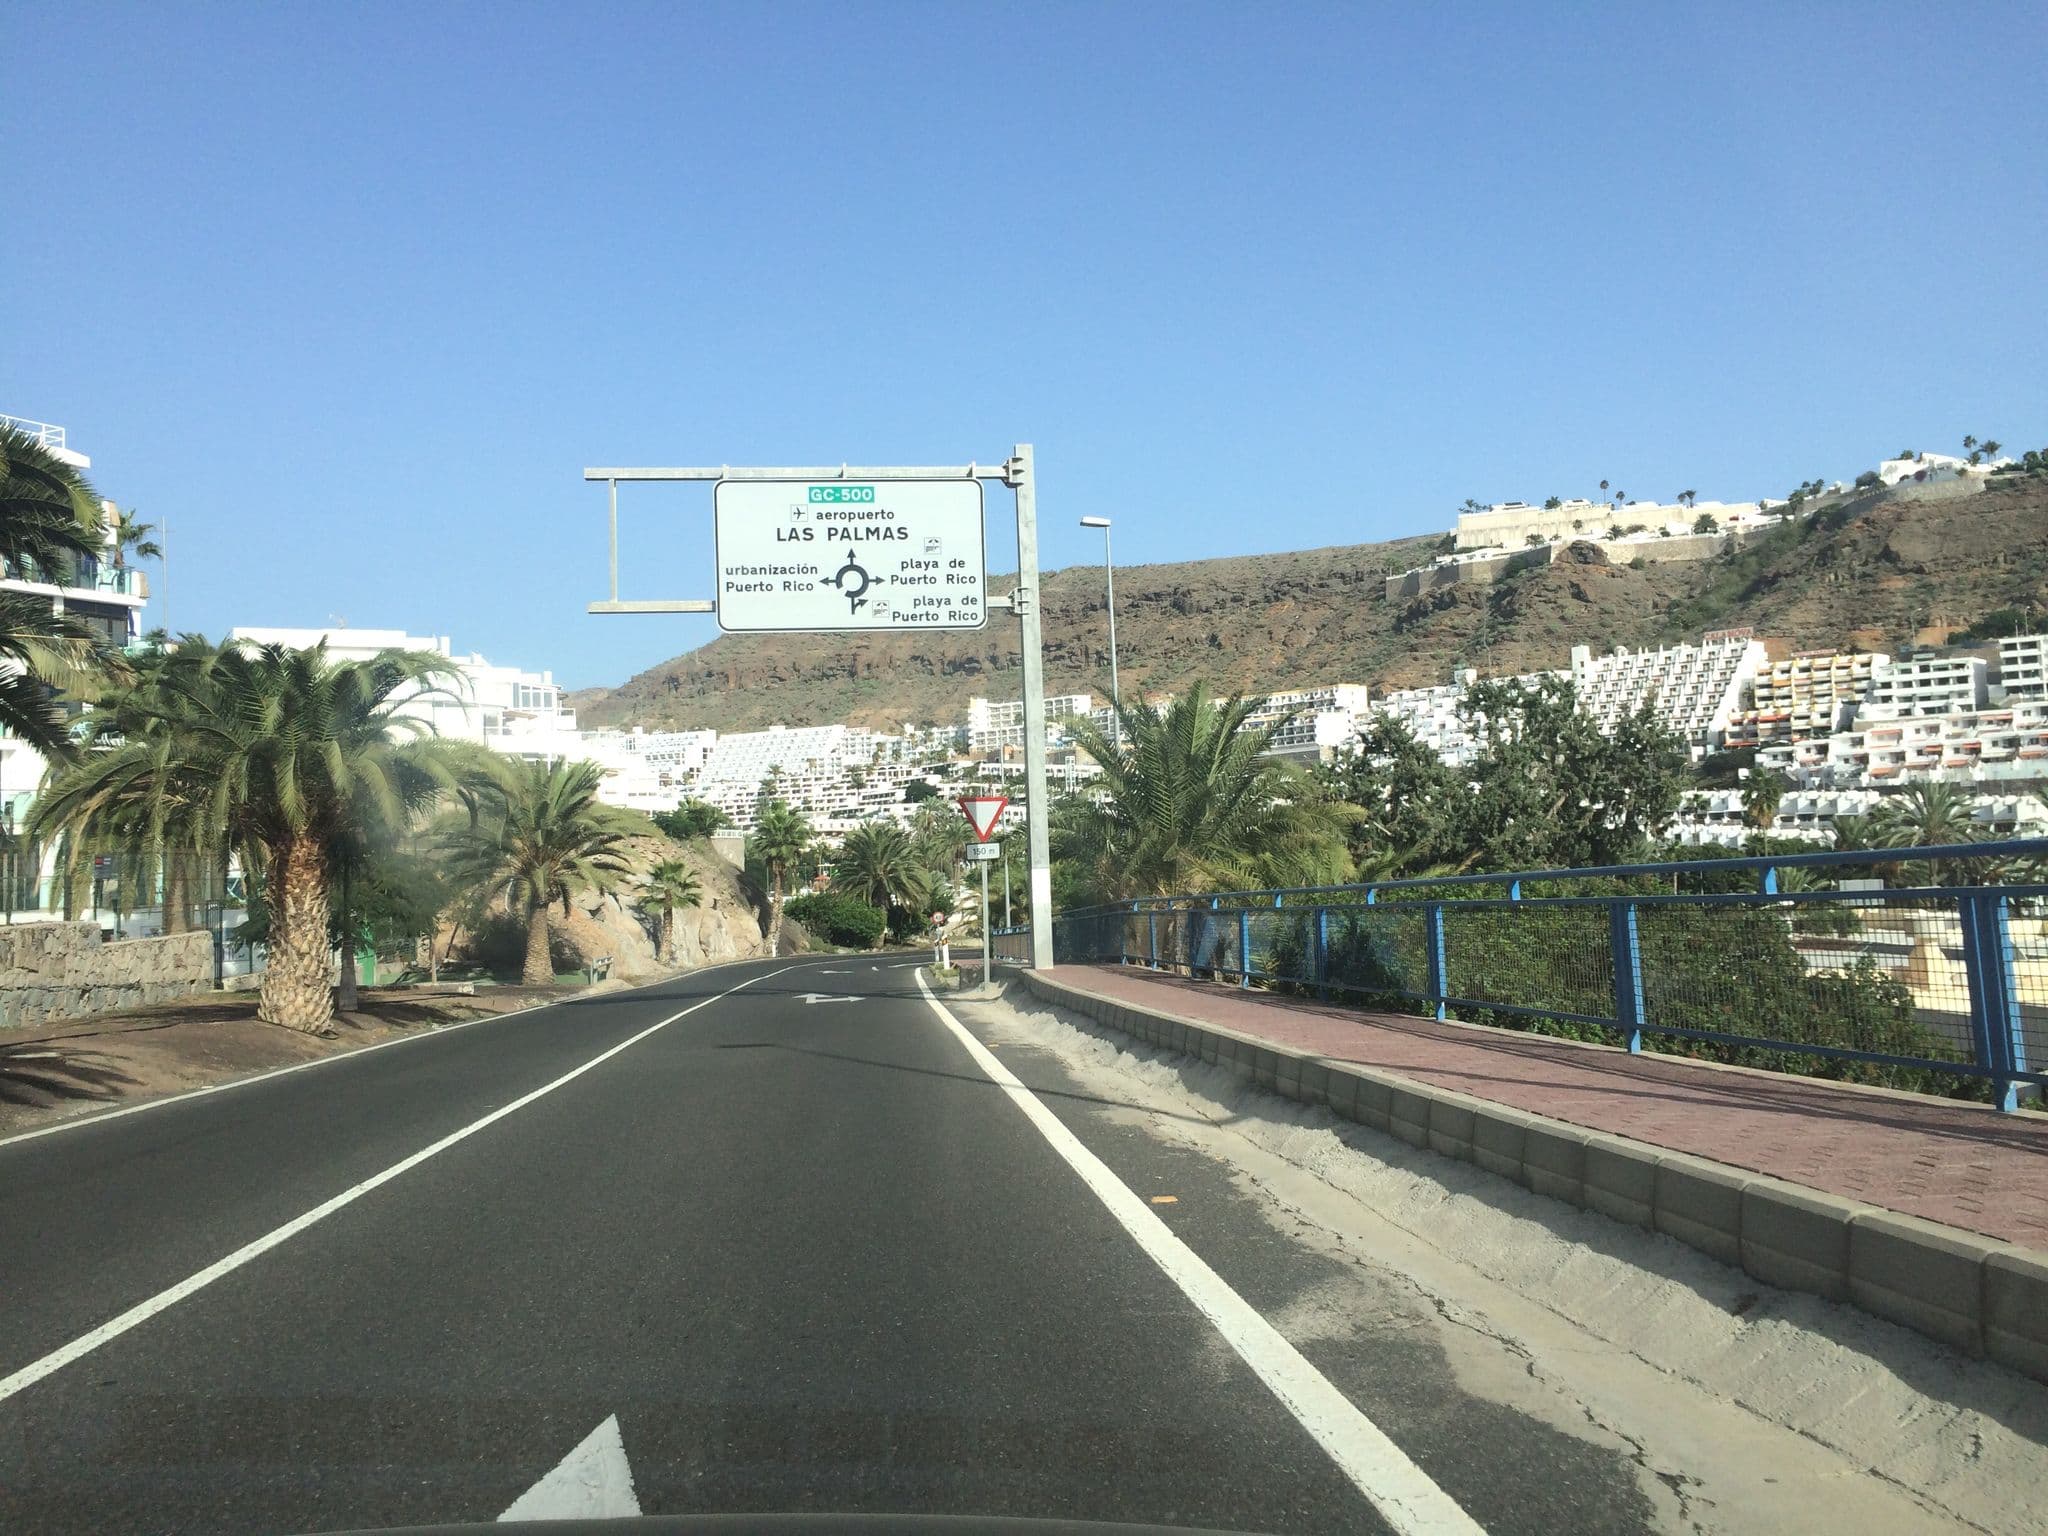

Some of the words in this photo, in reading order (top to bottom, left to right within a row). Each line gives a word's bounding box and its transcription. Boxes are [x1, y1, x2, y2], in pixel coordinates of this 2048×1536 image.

[811, 489, 873, 501] GC-500
[816, 509, 895, 522] aeropuerto
[777, 527, 814, 542] LAS
[827, 527, 909, 541] PALMAS
[726, 564, 818, 575] urbanización
[901, 559, 939, 571] playa
[949, 558, 965, 568] de
[891, 575, 937, 585] Puerto
[946, 574, 977, 584] Rico
[726, 581, 773, 592] Puerto
[783, 581, 814, 591] Rico
[913, 596, 951, 608] playa
[961, 596, 978, 606] de
[892, 611, 939, 622] Puerto
[949, 610, 978, 621] Rico
[972, 847, 986, 856] 150
